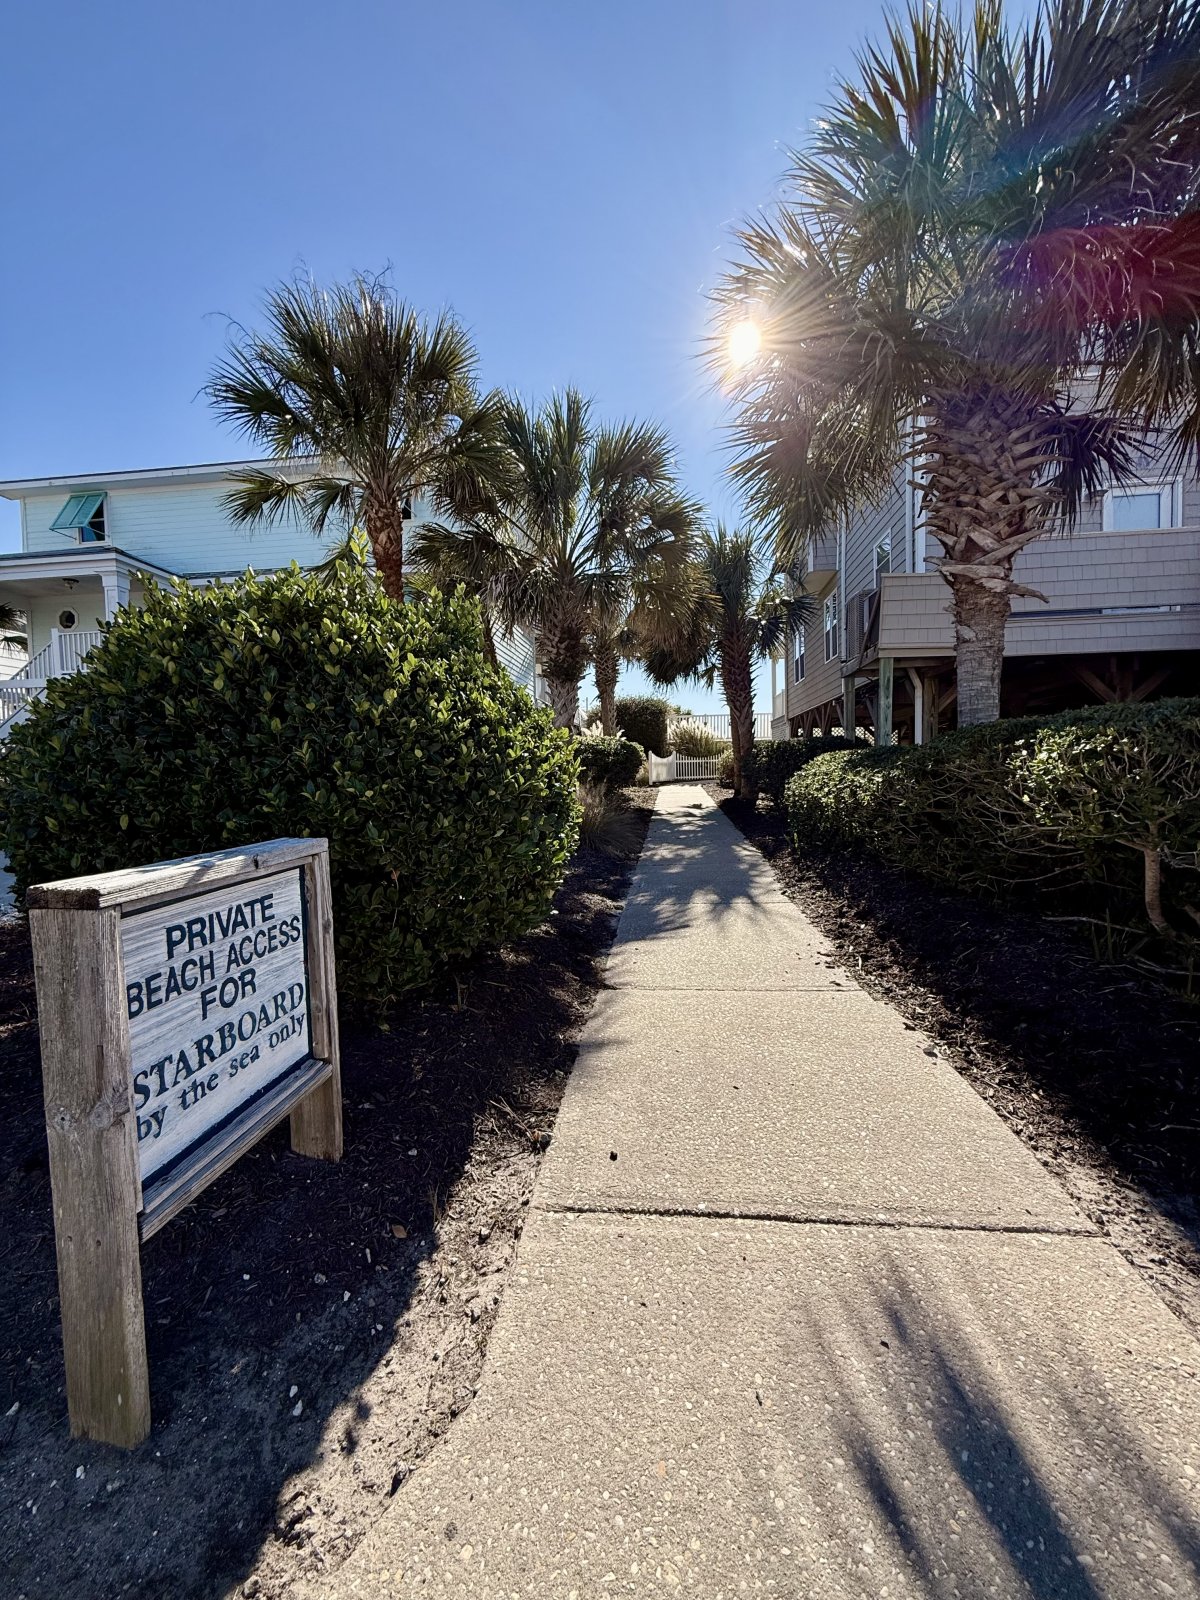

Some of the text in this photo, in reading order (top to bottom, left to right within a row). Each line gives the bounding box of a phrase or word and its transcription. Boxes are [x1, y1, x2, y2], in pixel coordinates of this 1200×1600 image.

[127, 915, 301, 1020] BEACH ACCESS
[165, 893, 275, 961] PRIVATE
[133, 982, 304, 1110] STARBOARD
[200, 967, 257, 1021] FOR
[136, 1012, 305, 1143] by the sea only
